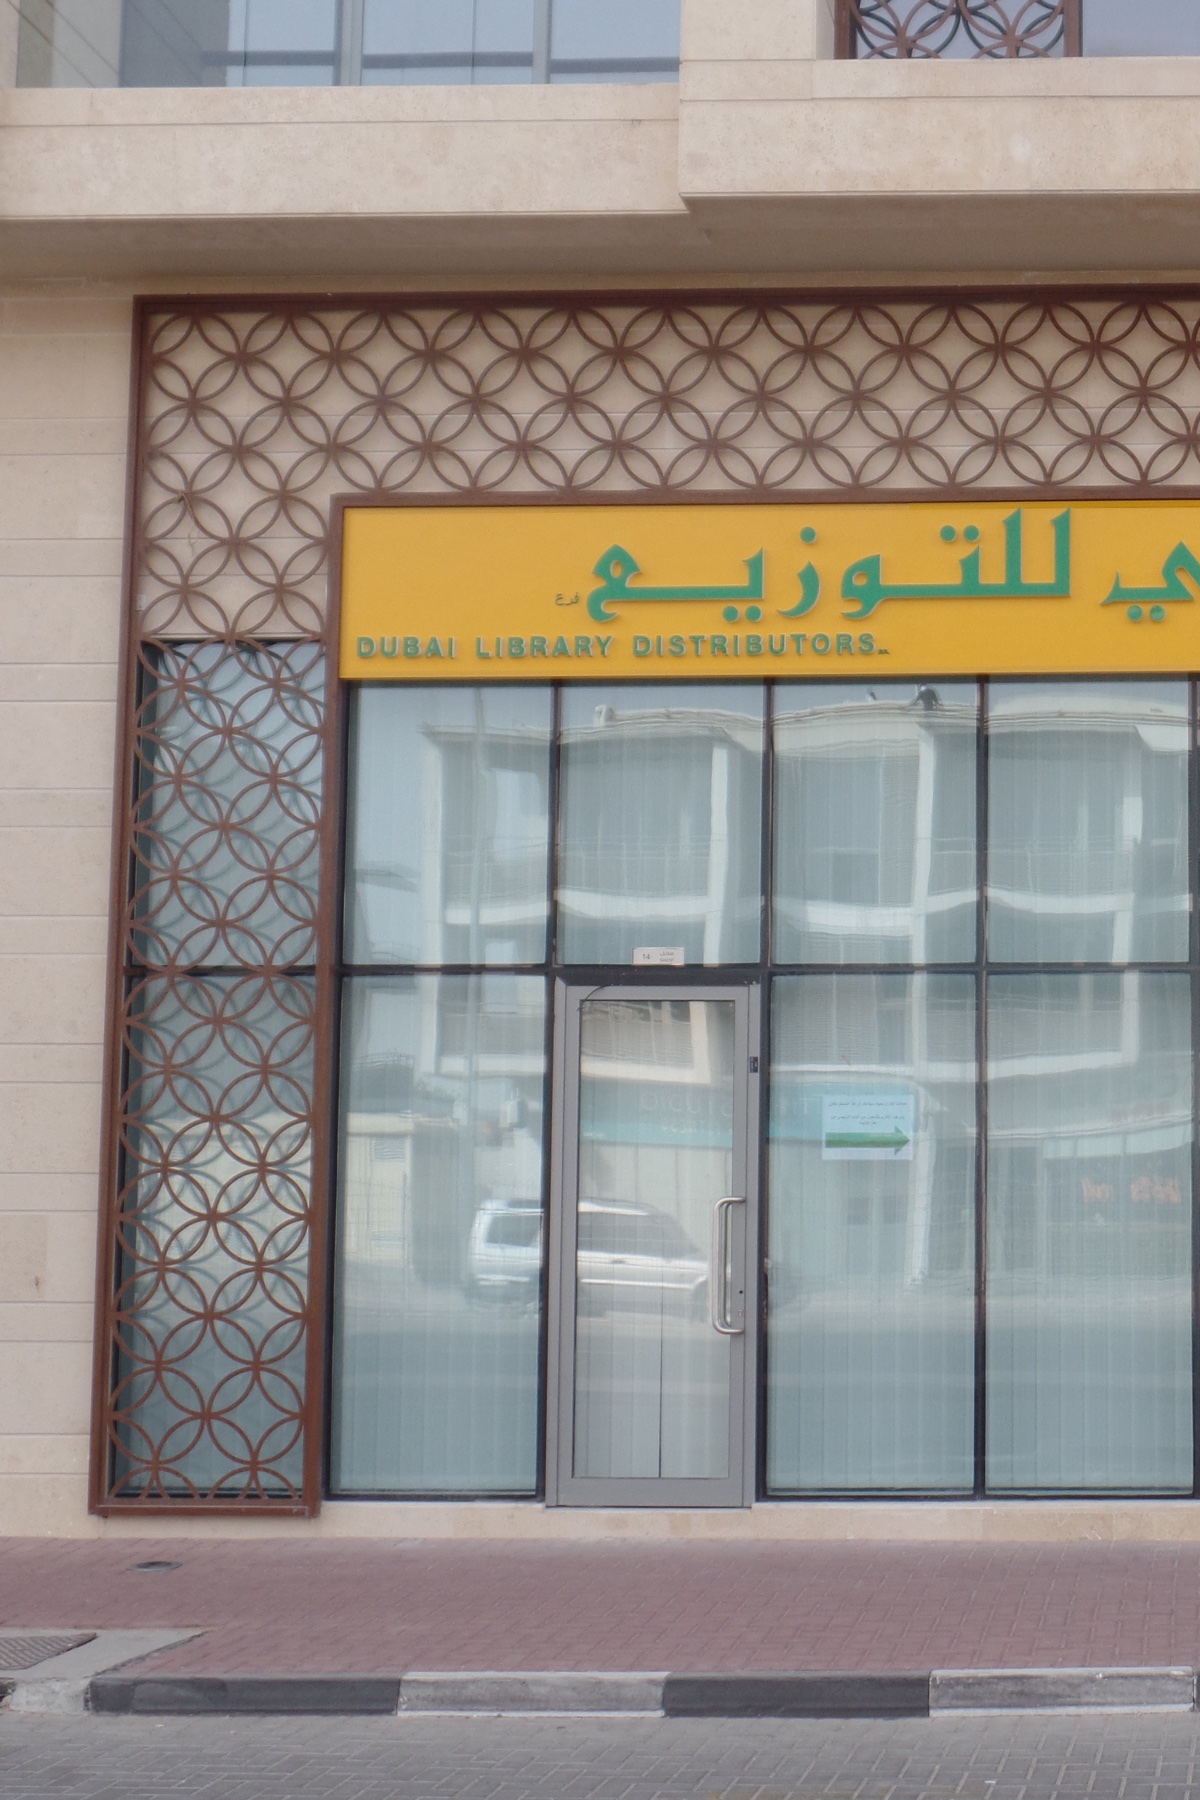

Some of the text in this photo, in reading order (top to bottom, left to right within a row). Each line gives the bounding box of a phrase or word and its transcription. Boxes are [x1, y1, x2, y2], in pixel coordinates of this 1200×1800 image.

[586, 507, 1071, 622] للتوزيع
[356, 636, 456, 658] DUBAI
[475, 635, 613, 658] LIBRARY
[632, 632, 876, 656] DISTRIBUTORS
